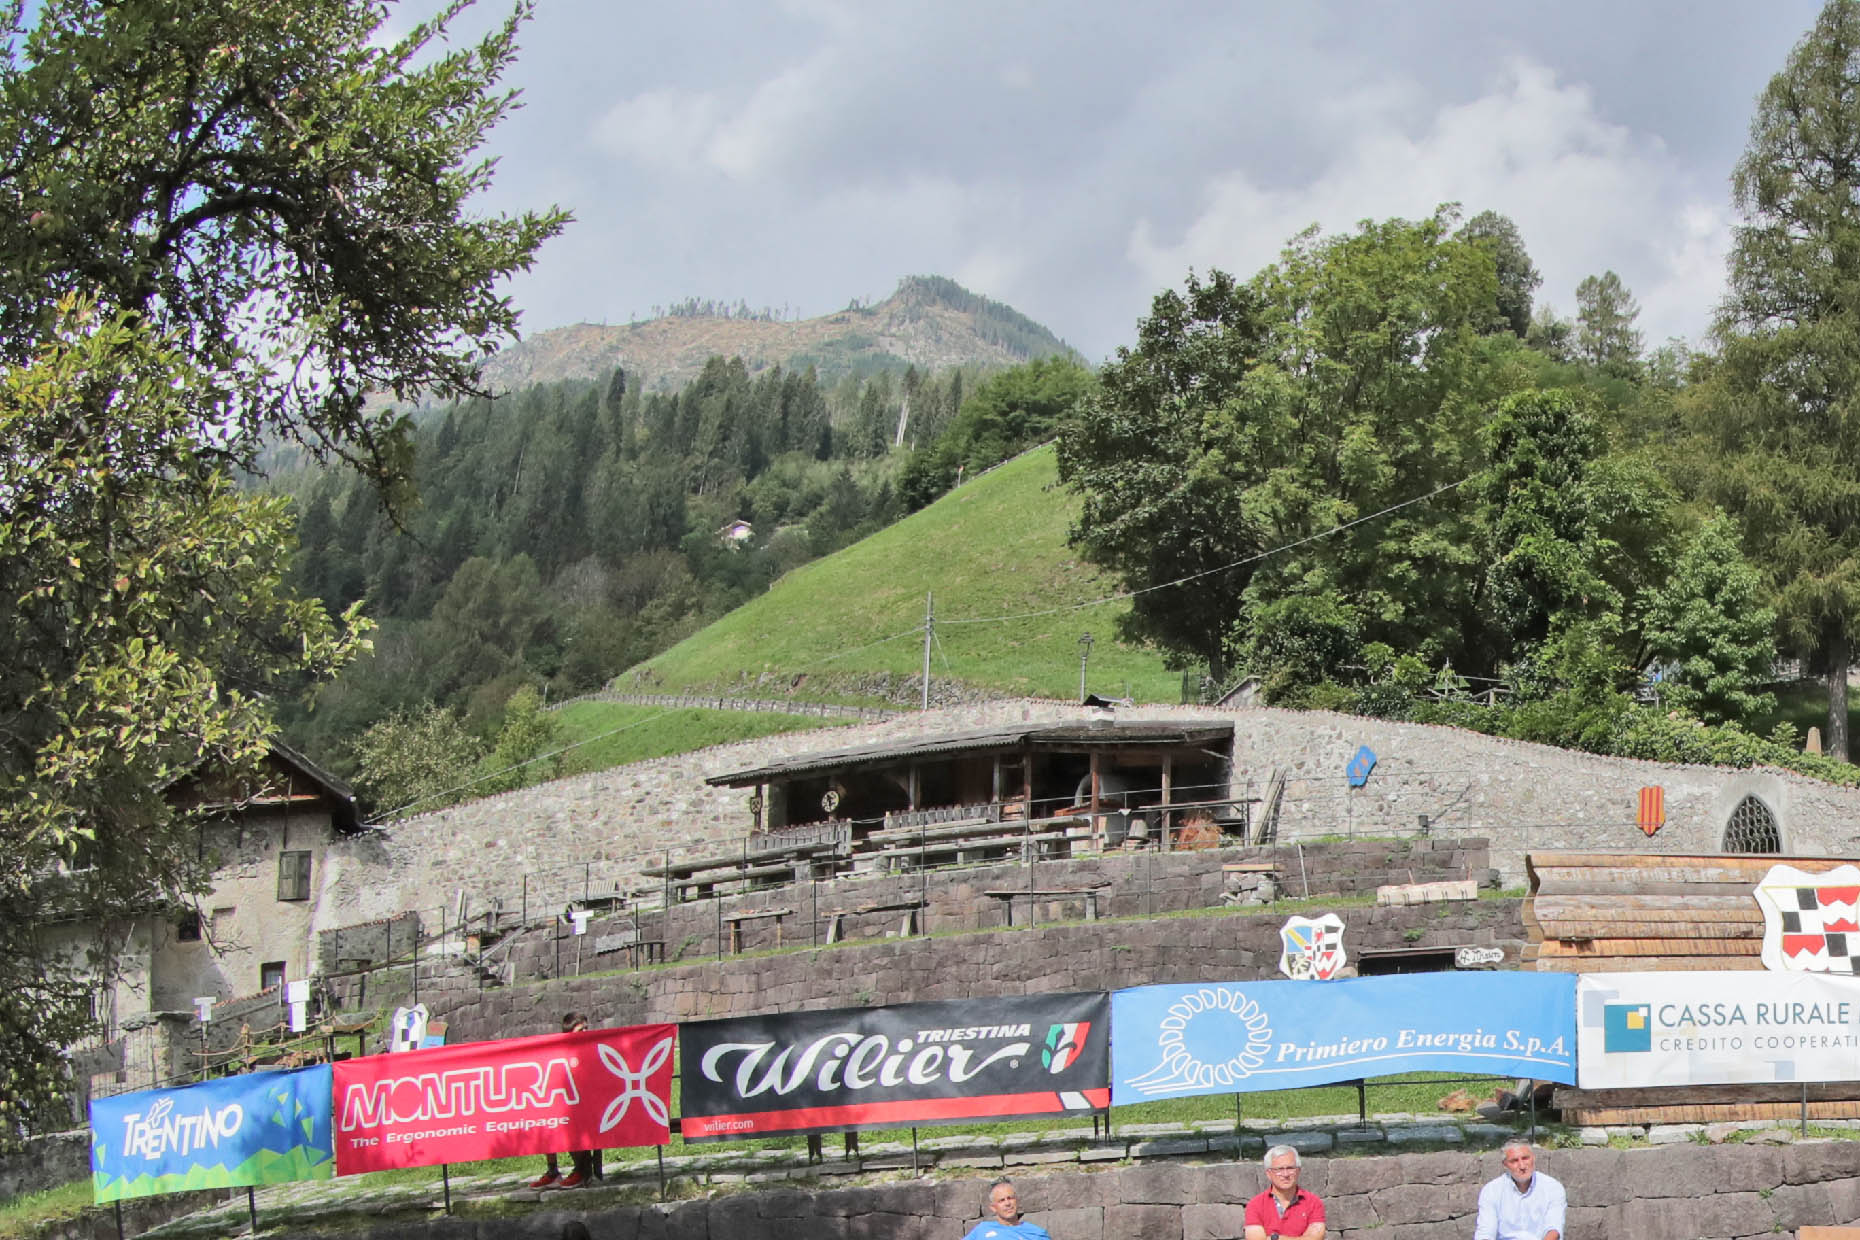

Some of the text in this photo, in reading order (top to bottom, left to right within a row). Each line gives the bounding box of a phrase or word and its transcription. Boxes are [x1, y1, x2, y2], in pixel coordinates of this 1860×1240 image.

[1658, 1003, 1747, 1028] CASSA
[1756, 1002, 1851, 1025] RURALE
[917, 1023, 1031, 1044] TRIESTINA
[1275, 1028, 1571, 1063] Primiero Energia S.p.A.
[1660, 1036, 1743, 1052] CREDITO
[701, 1032, 1032, 1099] Wilier
[341, 1058, 580, 1132] MONTURA
[122, 1103, 244, 1161] TRENTINO
[350, 1114, 571, 1149] The Ergonomic Equipage
[703, 1118, 754, 1133] wilier.com
